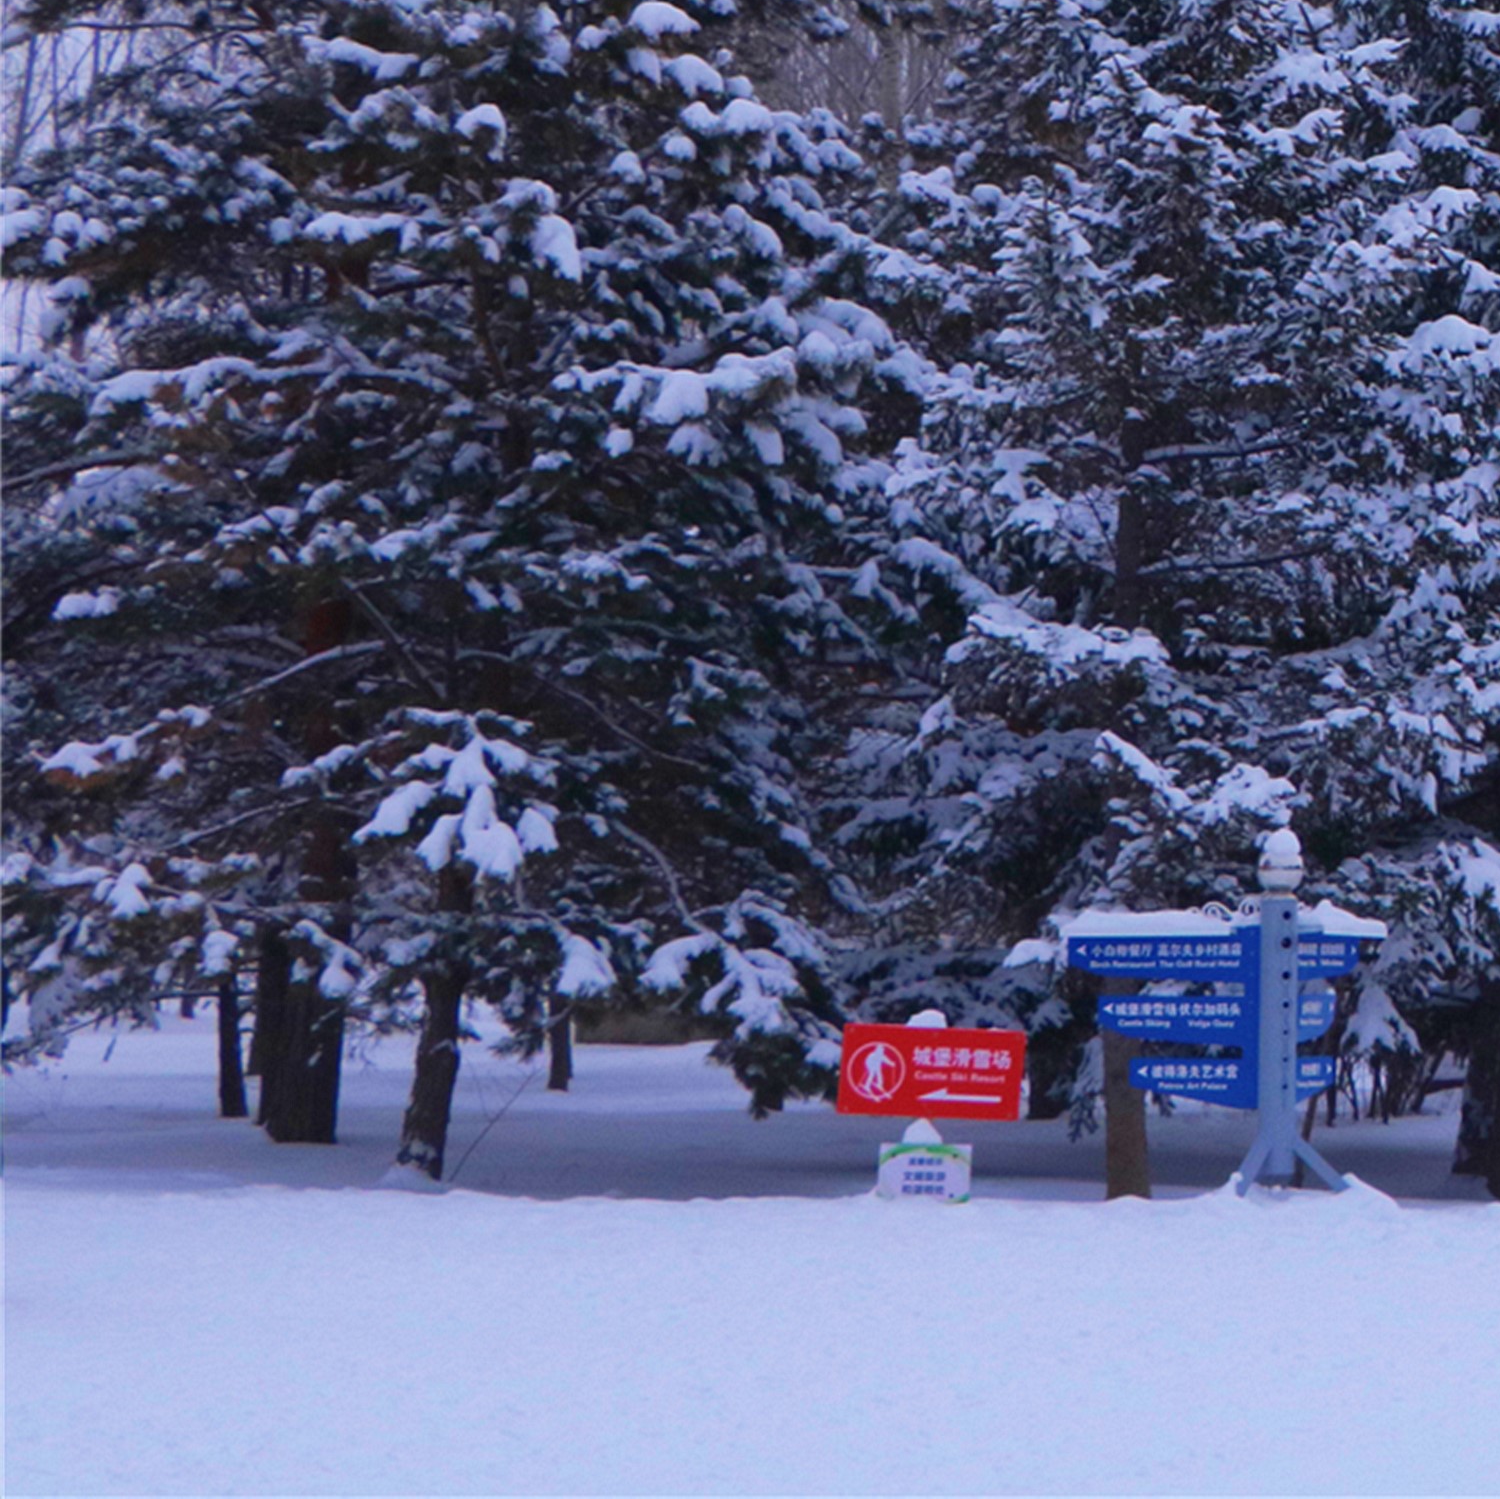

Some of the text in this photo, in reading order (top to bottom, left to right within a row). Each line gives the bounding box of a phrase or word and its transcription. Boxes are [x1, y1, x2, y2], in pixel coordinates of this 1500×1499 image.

[1112, 959, 1156, 969] Restaurant
[1159, 959, 1174, 969] The
[1117, 1018, 1143, 1028] Castle
[913, 1046, 1013, 1070] 城堡滑雪场
[914, 1070, 1005, 1084] Castle Ski Resort
